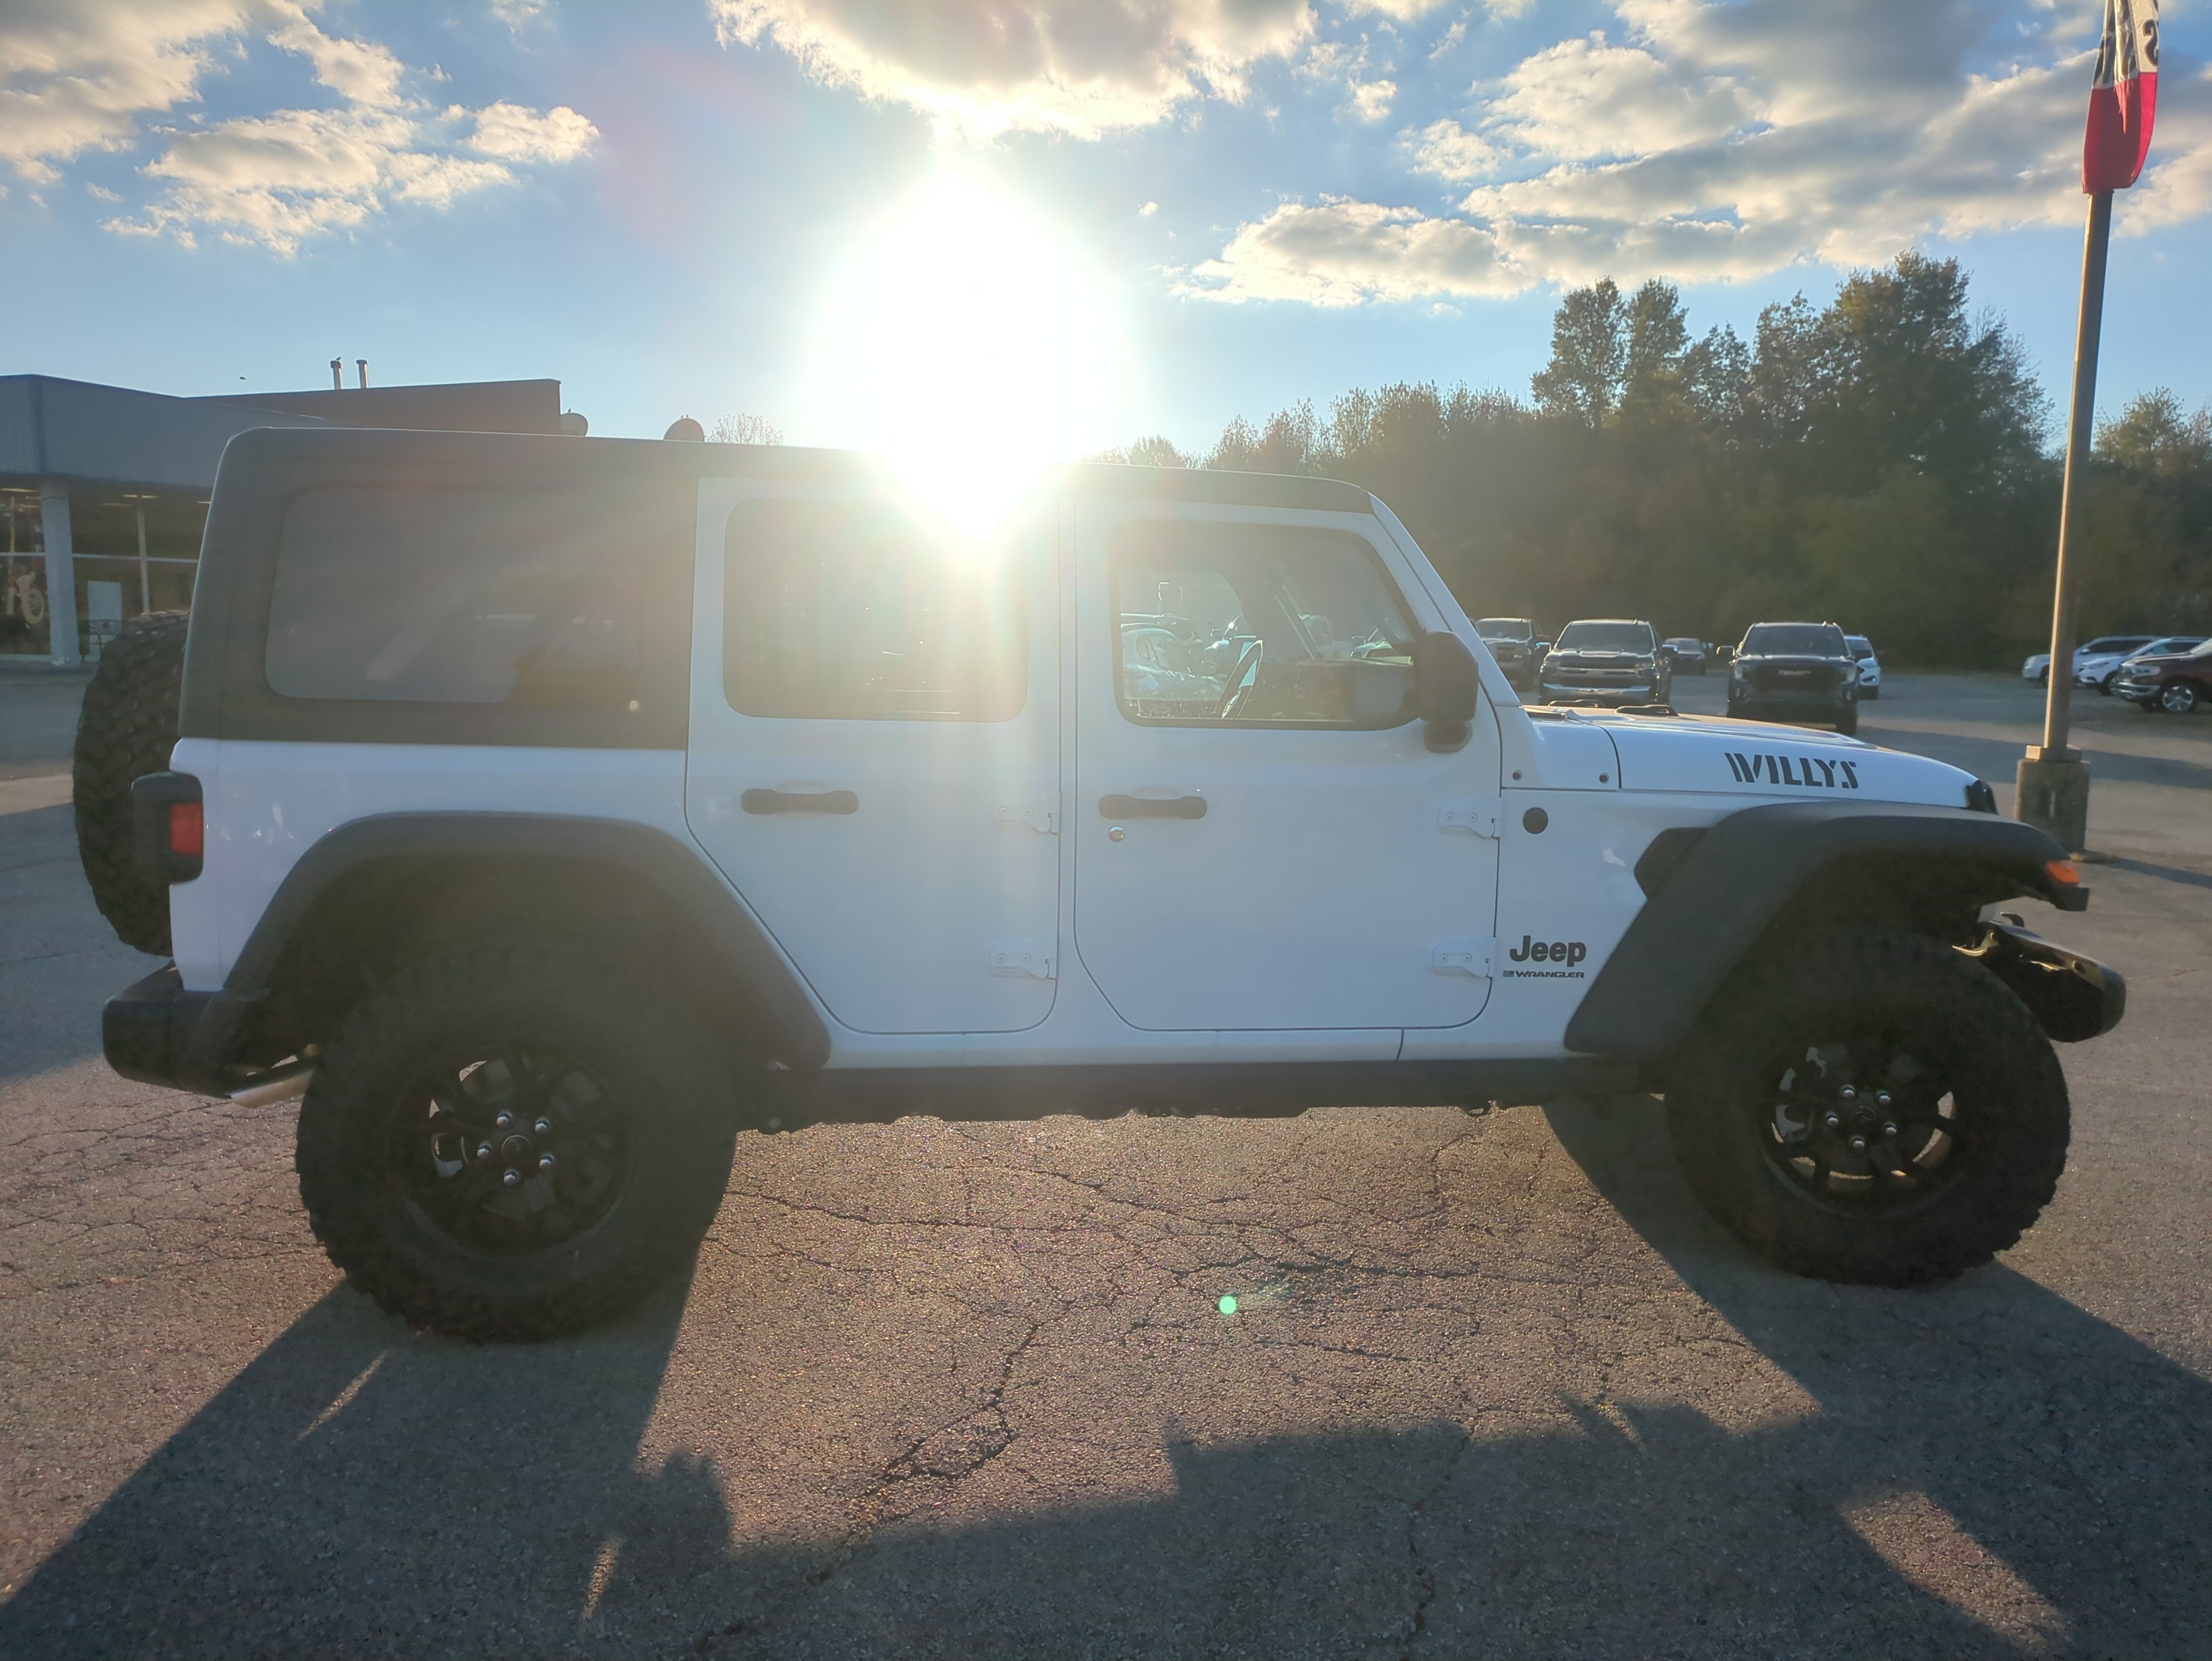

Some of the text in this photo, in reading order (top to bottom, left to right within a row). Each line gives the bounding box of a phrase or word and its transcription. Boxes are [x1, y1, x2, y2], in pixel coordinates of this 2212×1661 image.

[1724, 752, 1858, 789] WILLYS
[1510, 935, 1586, 967] Jeep
[1515, 970, 1585, 978] WRANGLER
